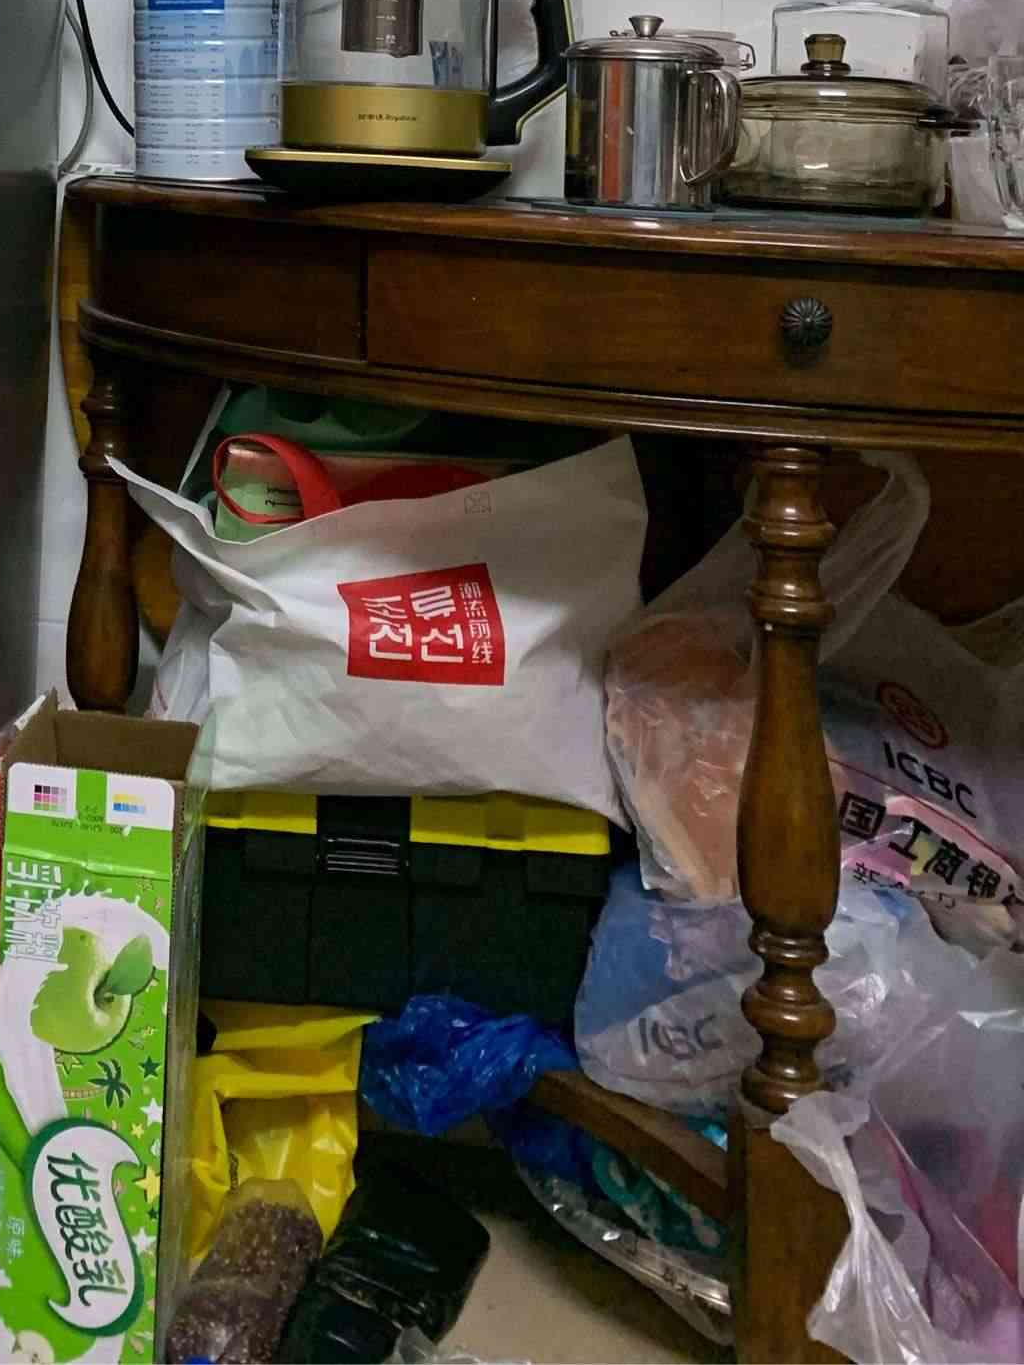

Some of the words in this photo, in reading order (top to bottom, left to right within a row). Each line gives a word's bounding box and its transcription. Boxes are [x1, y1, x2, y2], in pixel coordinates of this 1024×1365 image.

[459, 582, 494, 665] 潮流前线
[883, 741, 977, 819] ICBC
[639, 1014, 723, 1061] ICBC
[46, 1151, 129, 1308] 优酸乳
